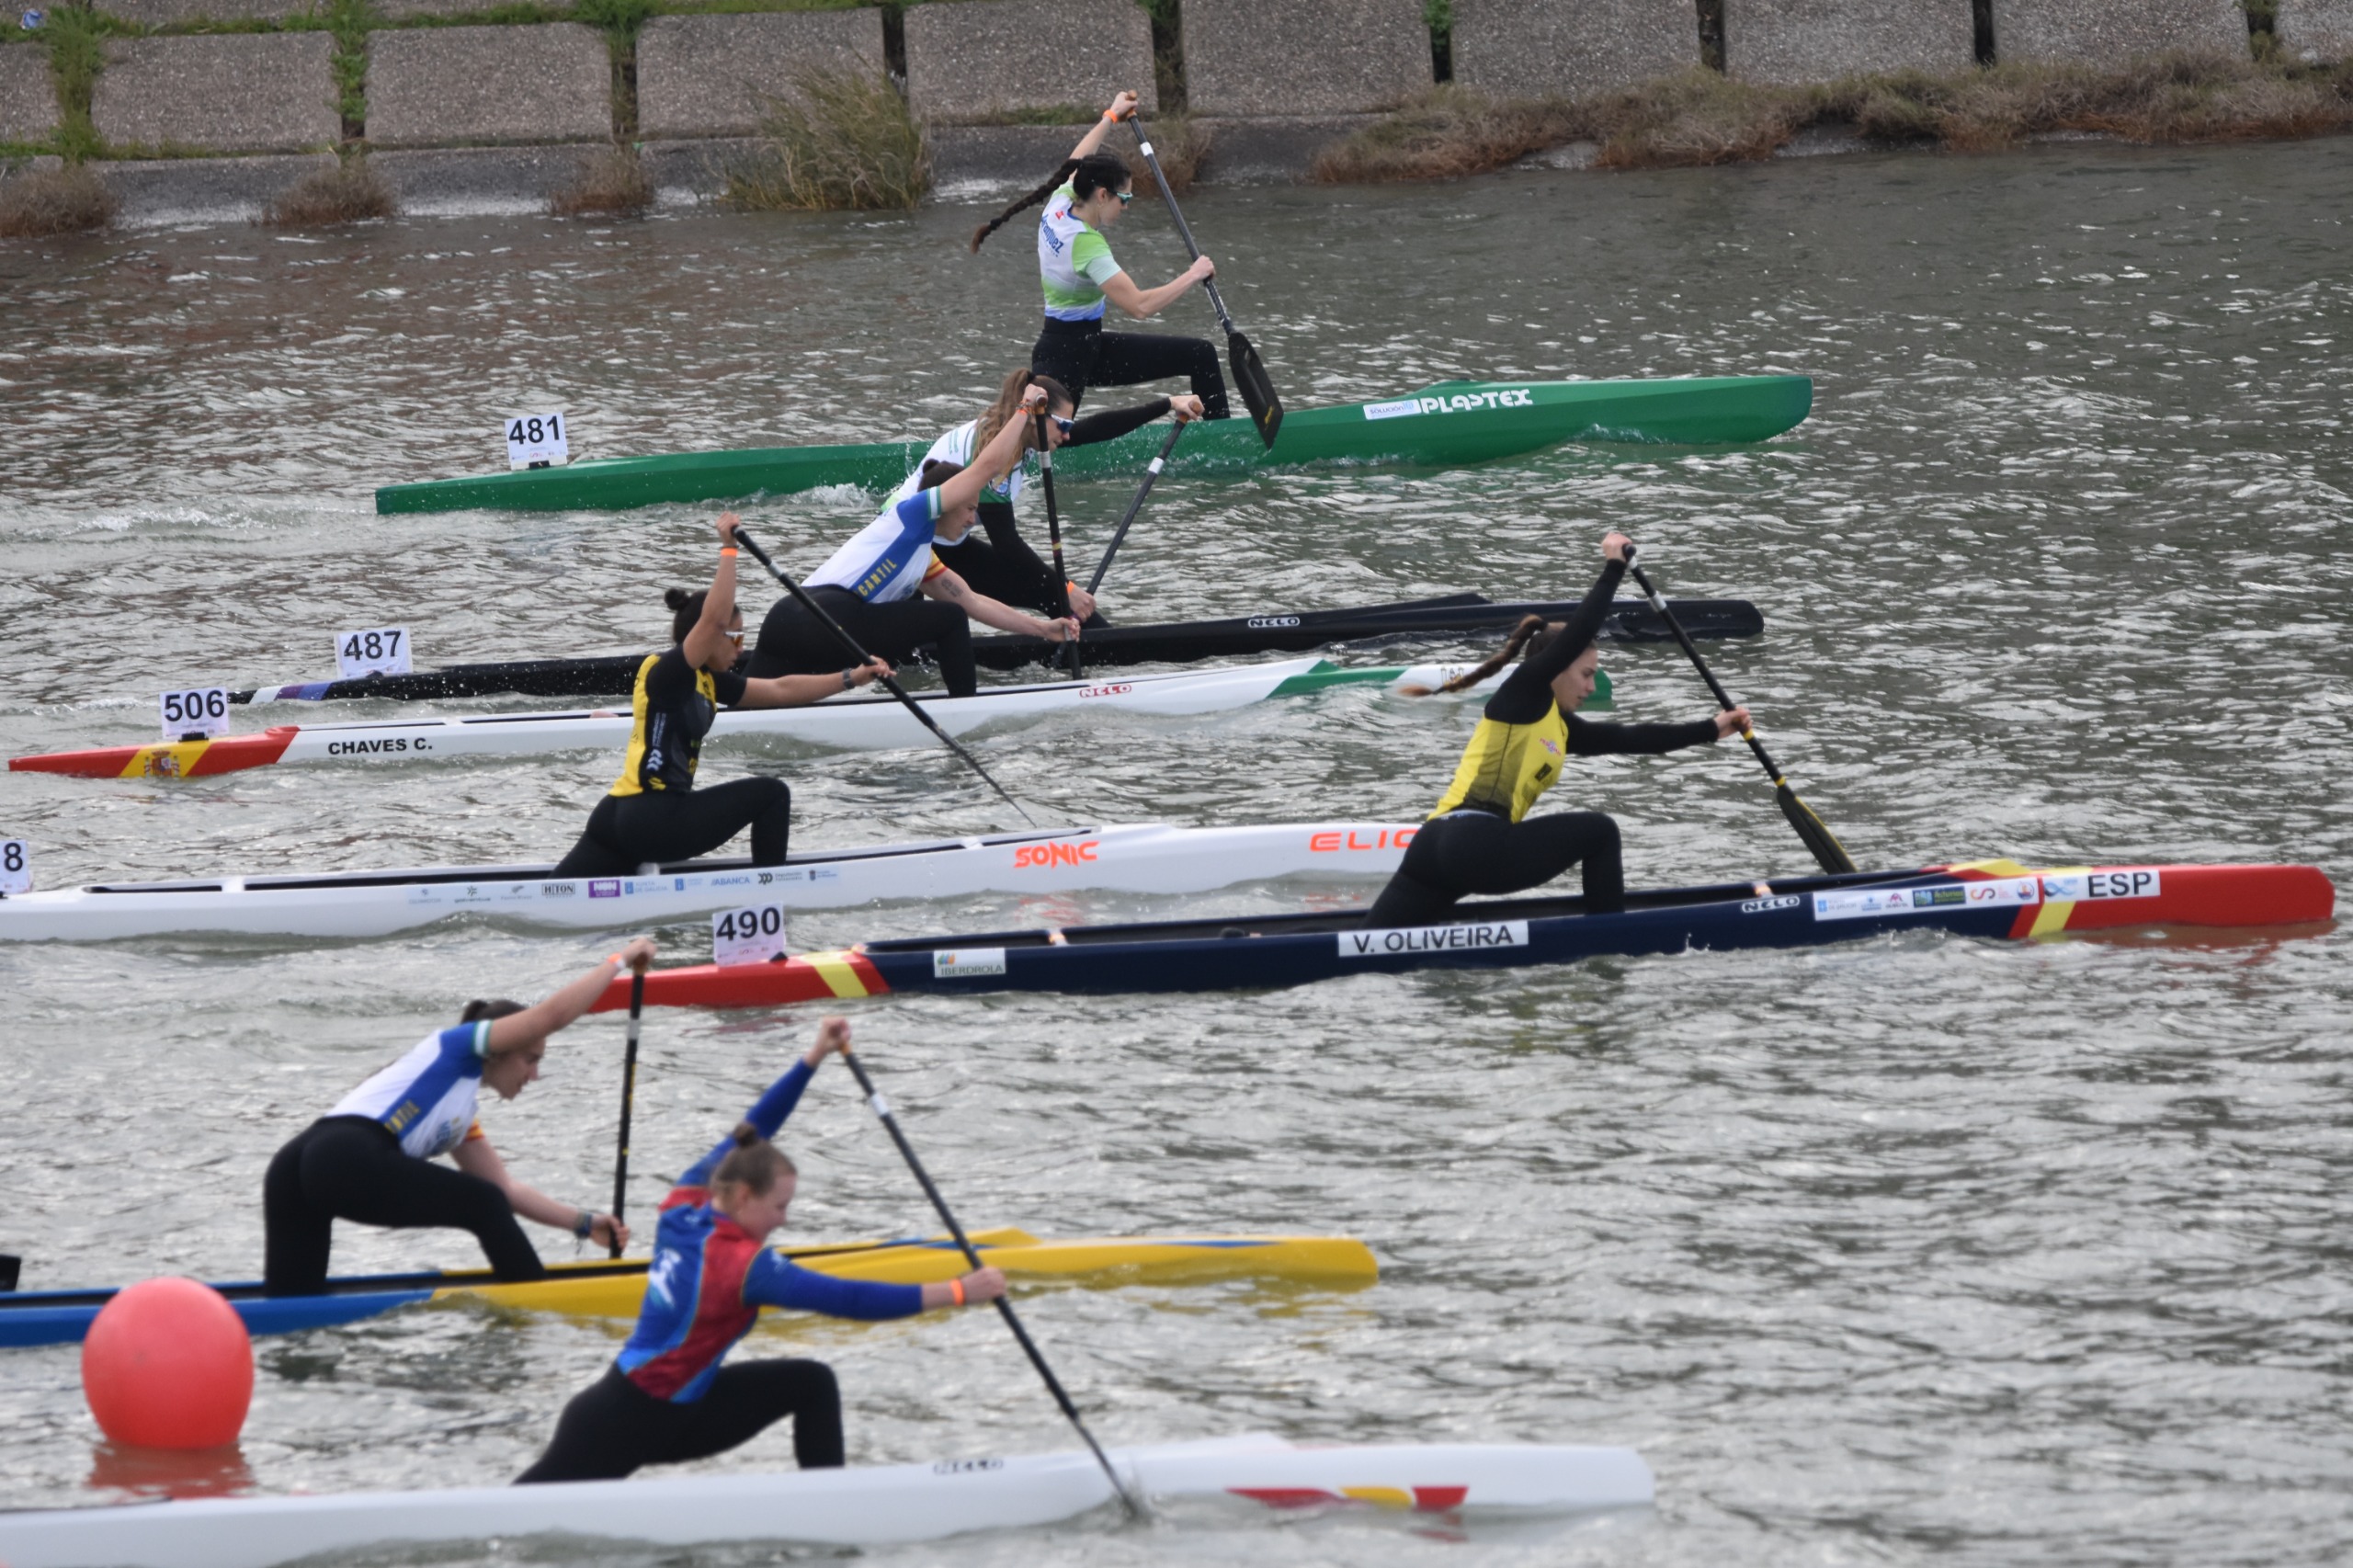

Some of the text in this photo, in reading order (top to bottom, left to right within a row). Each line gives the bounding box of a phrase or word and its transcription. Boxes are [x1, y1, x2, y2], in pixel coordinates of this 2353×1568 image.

[1419, 388, 1533, 415] PLASTEX
[508, 415, 560, 445] 481
[858, 558, 897, 597] CANTIL
[1248, 617, 1299, 628] NELO
[343, 630, 402, 661] 487
[1080, 684, 1131, 698] NELO
[165, 689, 225, 722] 506
[327, 737, 433, 756] CHAVES C.
[1013, 840, 1100, 869] SONIC
[2087, 871, 2153, 898] ESP
[1742, 896, 1800, 913] NELO
[716, 906, 780, 942] 490
[1353, 925, 1515, 953] V. OLIVEIRA
[940, 964, 1004, 976] IBERDROLA
